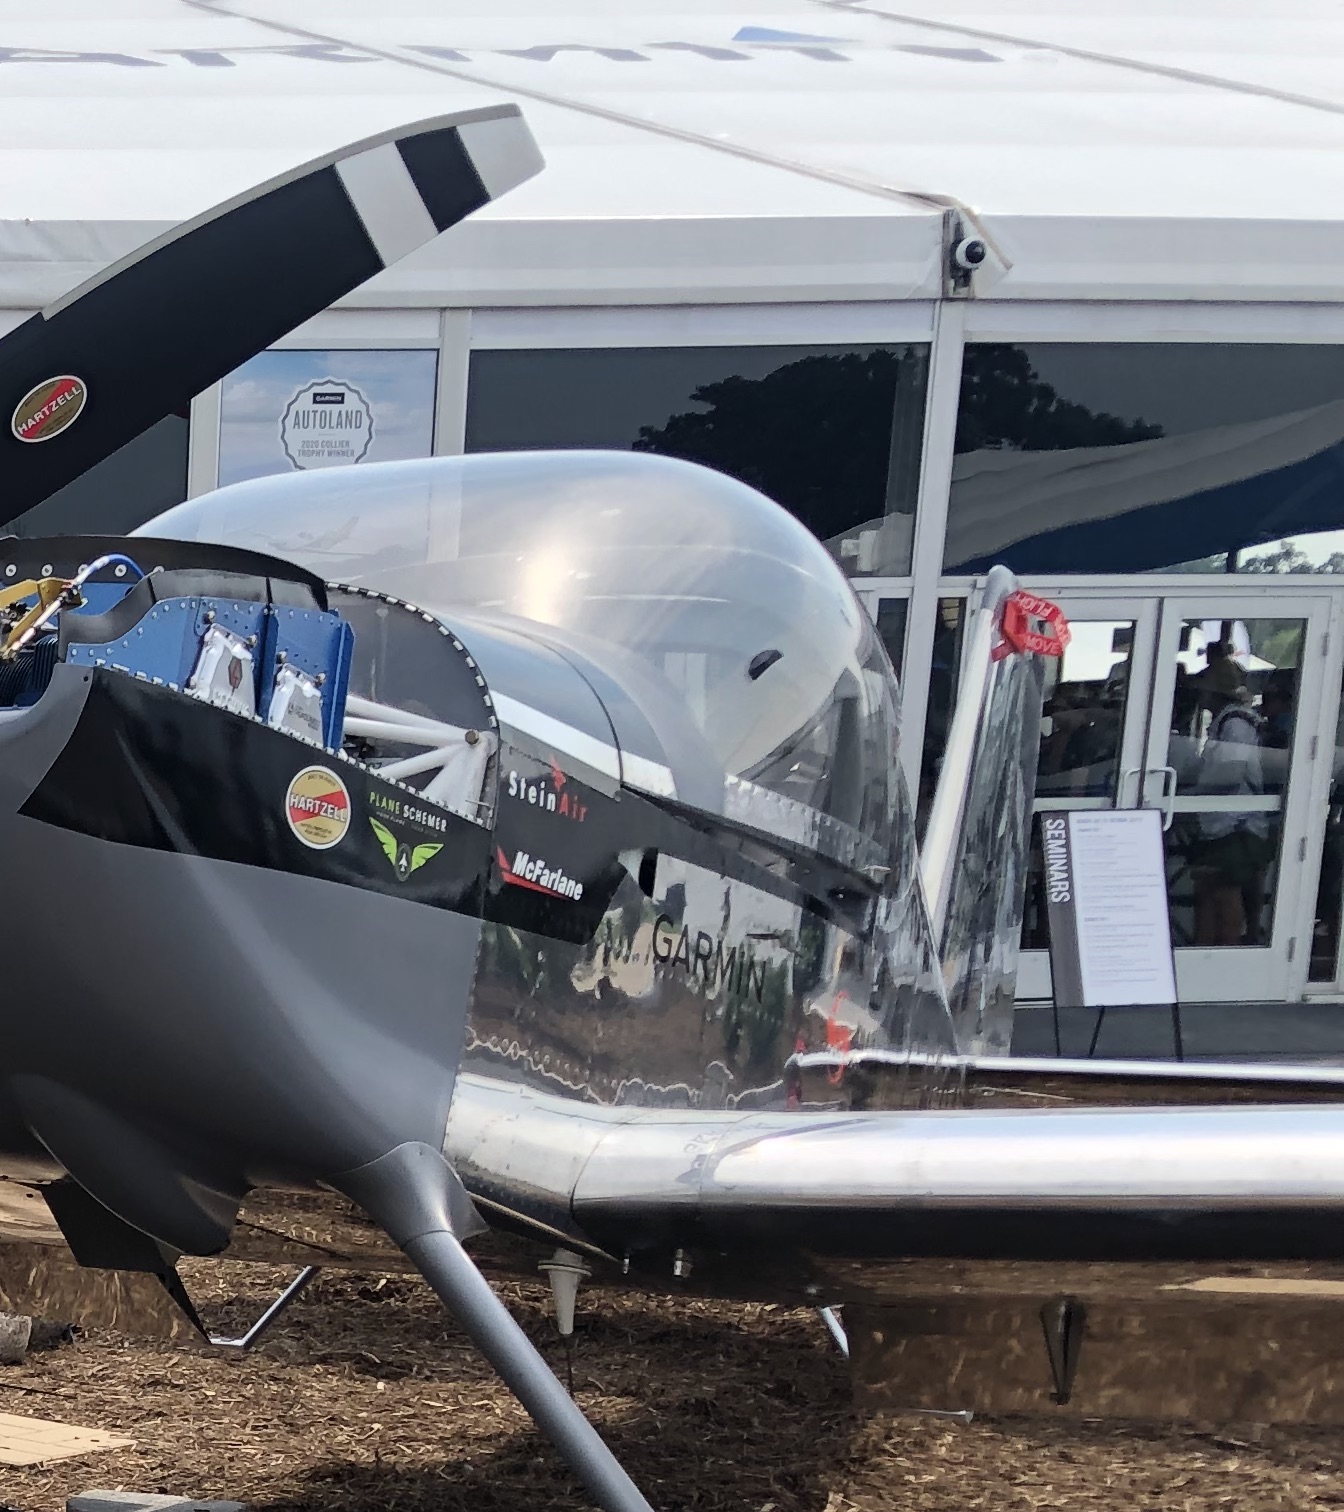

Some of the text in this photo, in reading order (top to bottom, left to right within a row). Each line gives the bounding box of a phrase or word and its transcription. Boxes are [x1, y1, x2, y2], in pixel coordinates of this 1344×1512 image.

[17, 386, 81, 434] HARTZELL
[293, 410, 362, 429] AUTOLAND
[321, 440, 350, 448] COLLIER
[289, 794, 347, 824] HARTZELL
[369, 792, 401, 815] PLANE
[403, 804, 448, 834] SCHEMER
[508, 770, 588, 823] SteinAir
[512, 850, 584, 901] McFarlane
[1045, 818, 1070, 904] SEMINARS
[653, 913, 767, 1004] GARMIN
